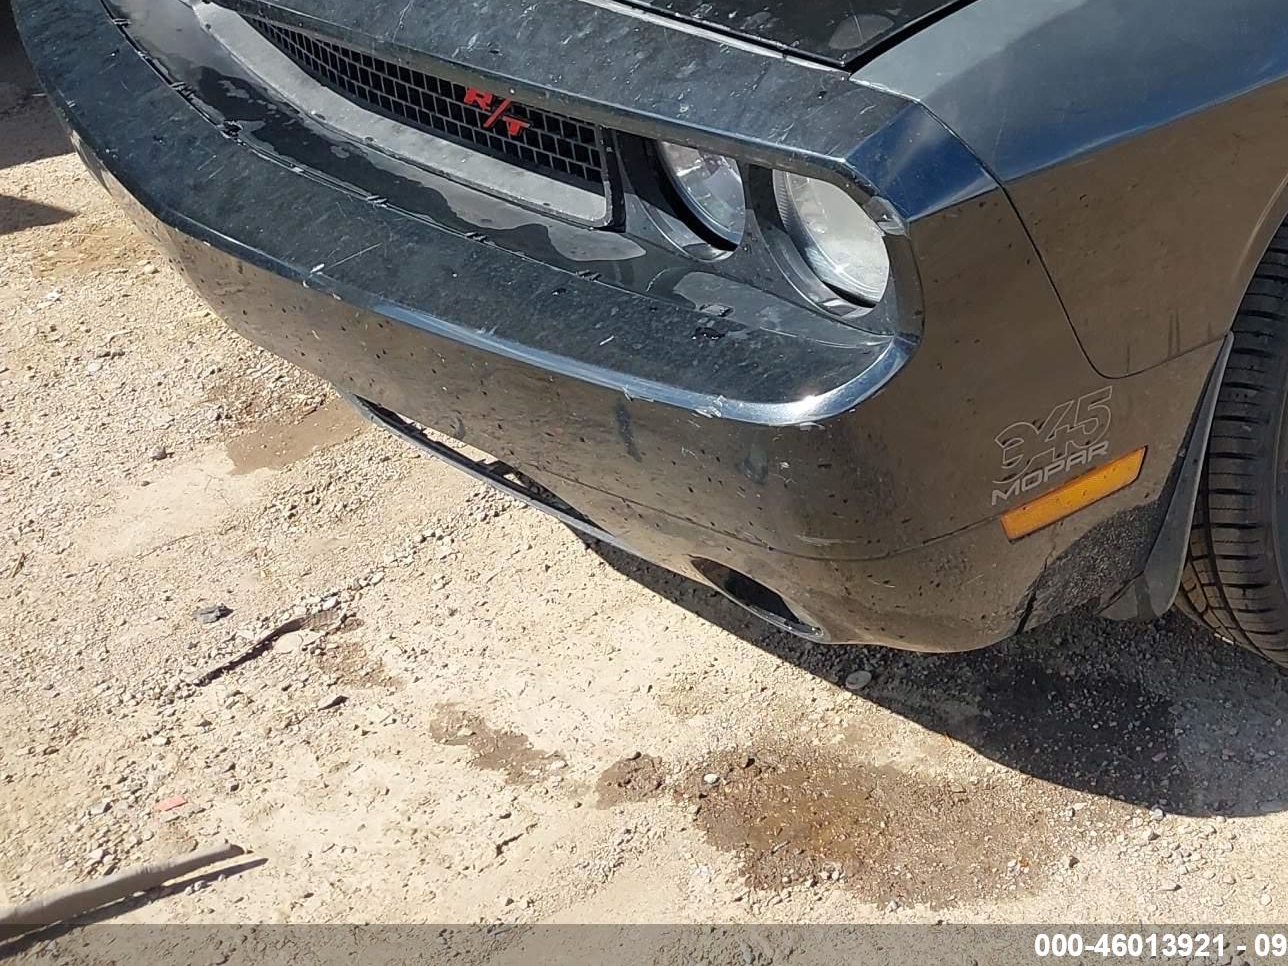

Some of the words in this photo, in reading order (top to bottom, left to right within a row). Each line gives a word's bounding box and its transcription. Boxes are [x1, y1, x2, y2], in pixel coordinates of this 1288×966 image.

[463, 85, 531, 137] R/T
[992, 385, 1113, 484] 345
[991, 440, 1110, 507] MOPAR
